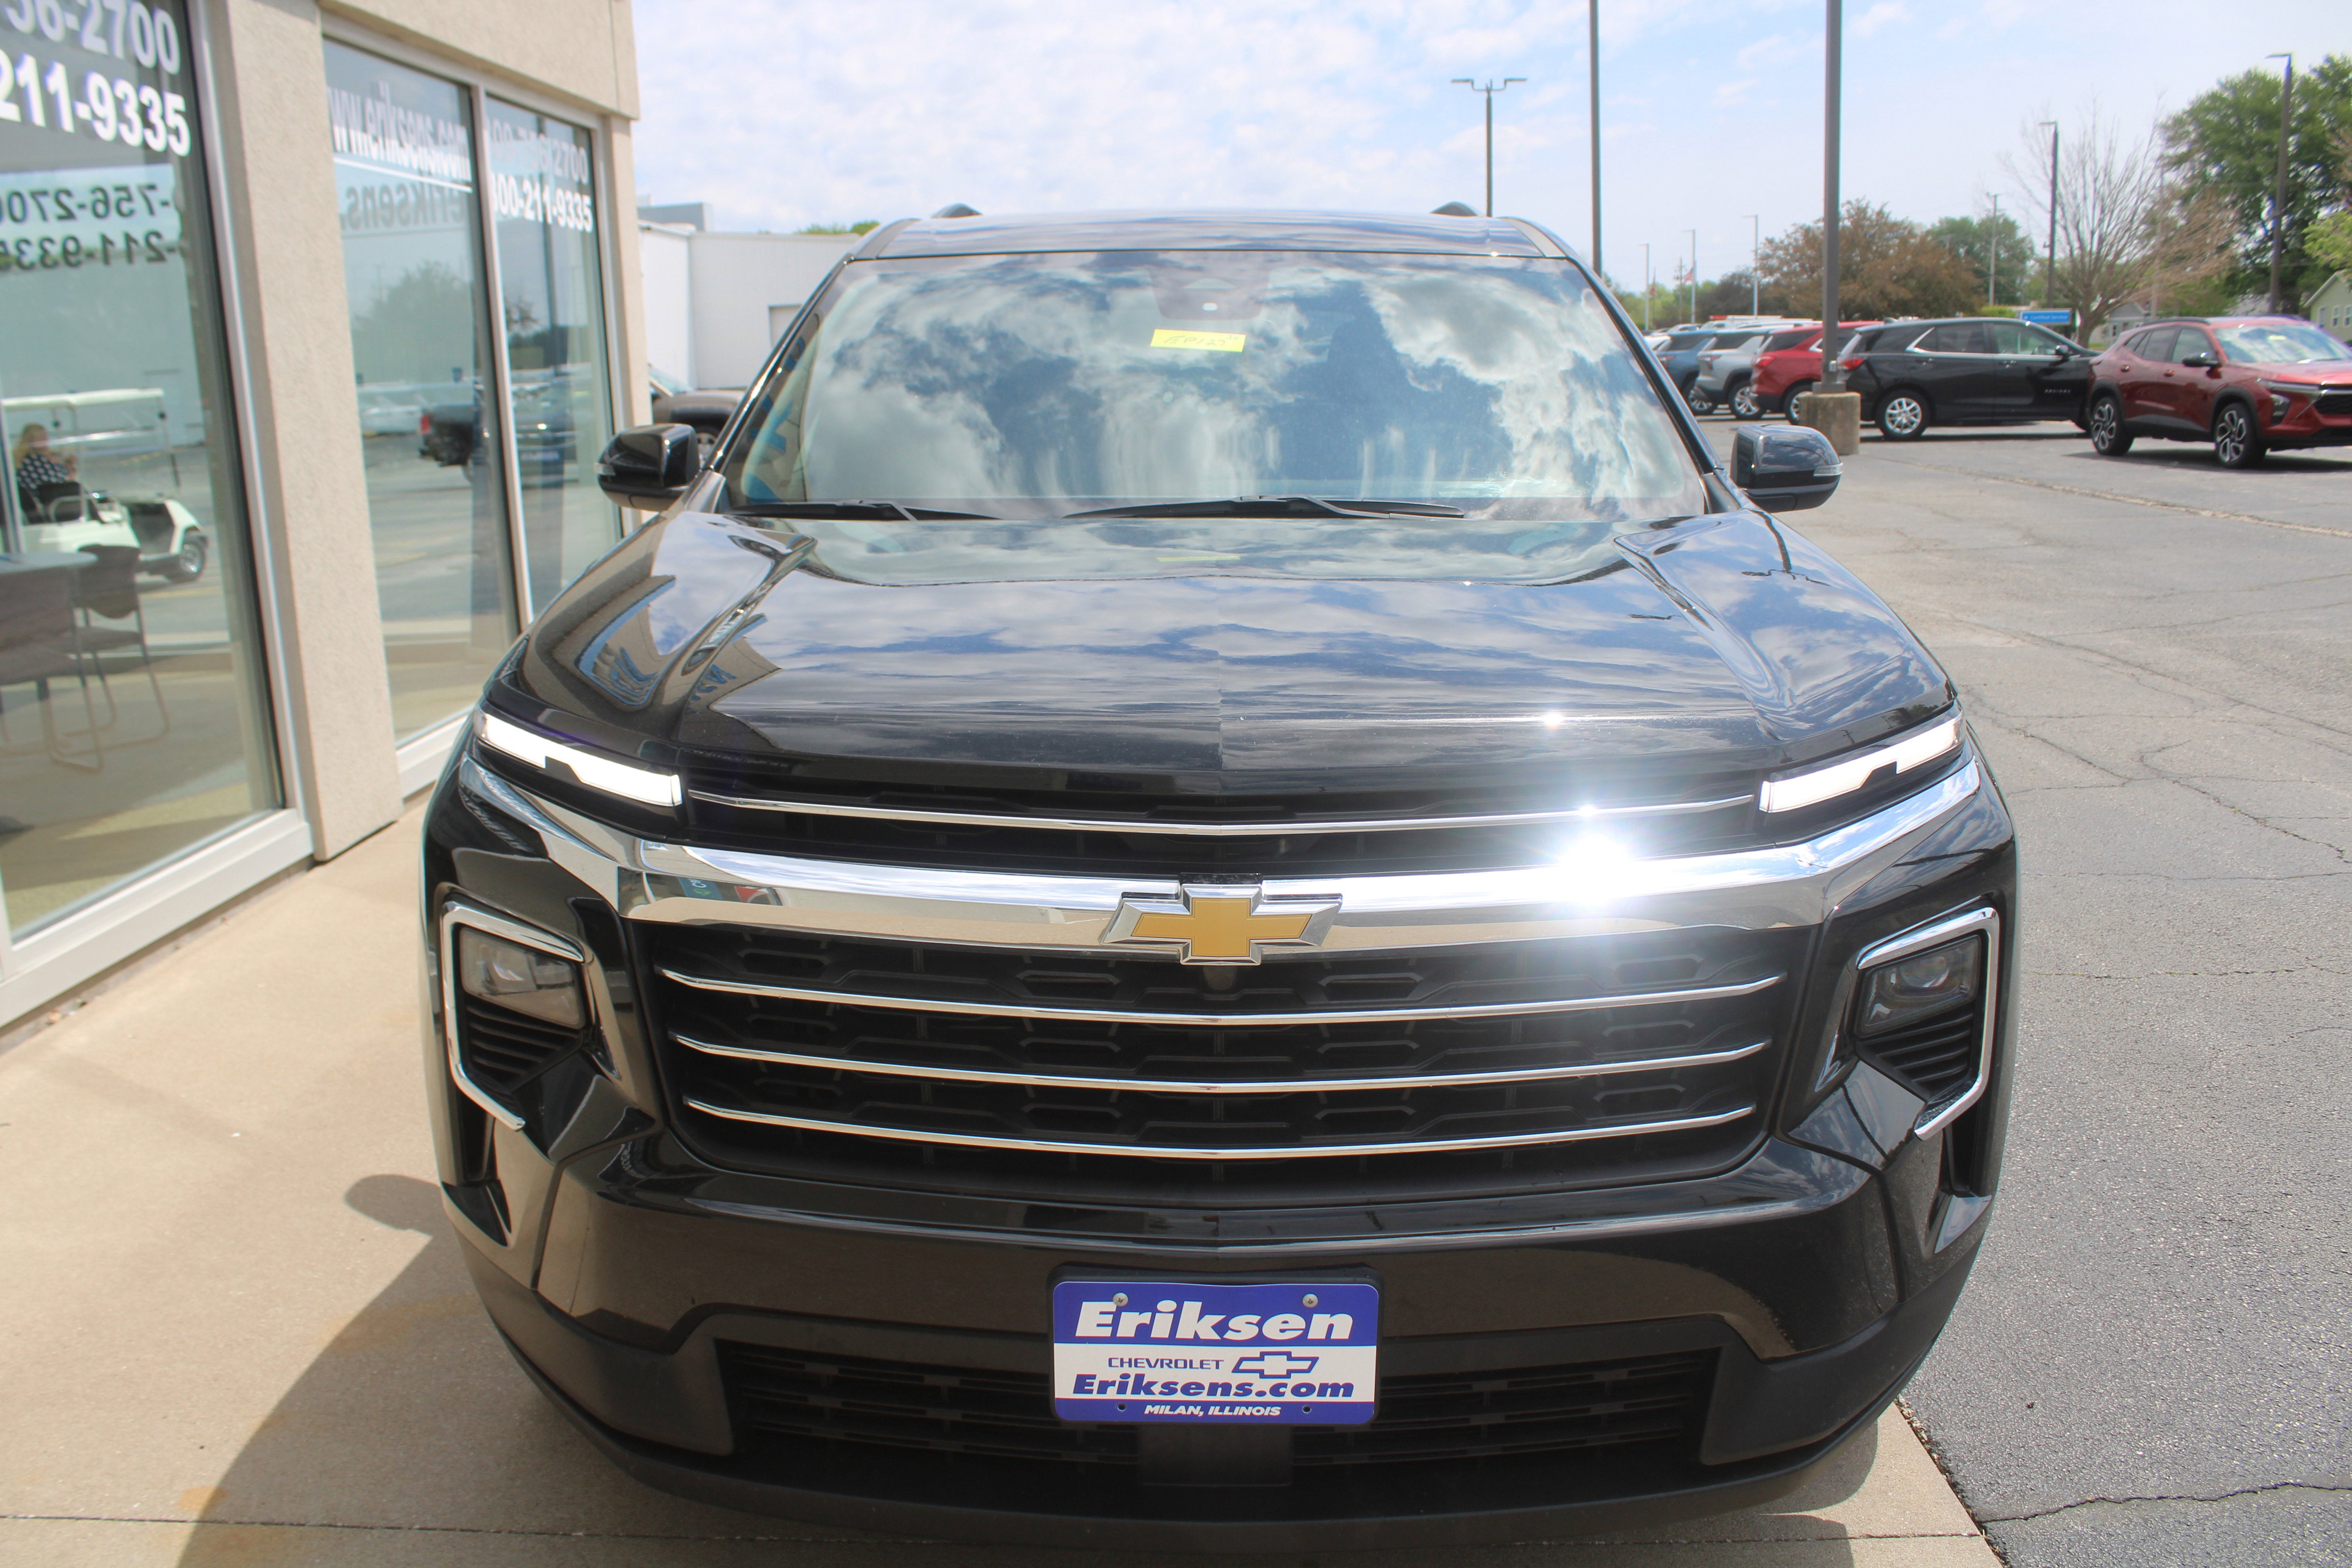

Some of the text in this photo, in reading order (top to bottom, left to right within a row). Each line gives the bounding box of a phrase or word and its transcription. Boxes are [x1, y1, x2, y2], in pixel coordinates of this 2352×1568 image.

[1075, 1299, 1354, 1340] Eriksen
[1108, 1357, 1224, 1370] CHEVROLET
[1073, 1373, 1354, 1398] Eriksens.com
[1144, 1405, 1281, 1416] MILAN, ILLINOIS
